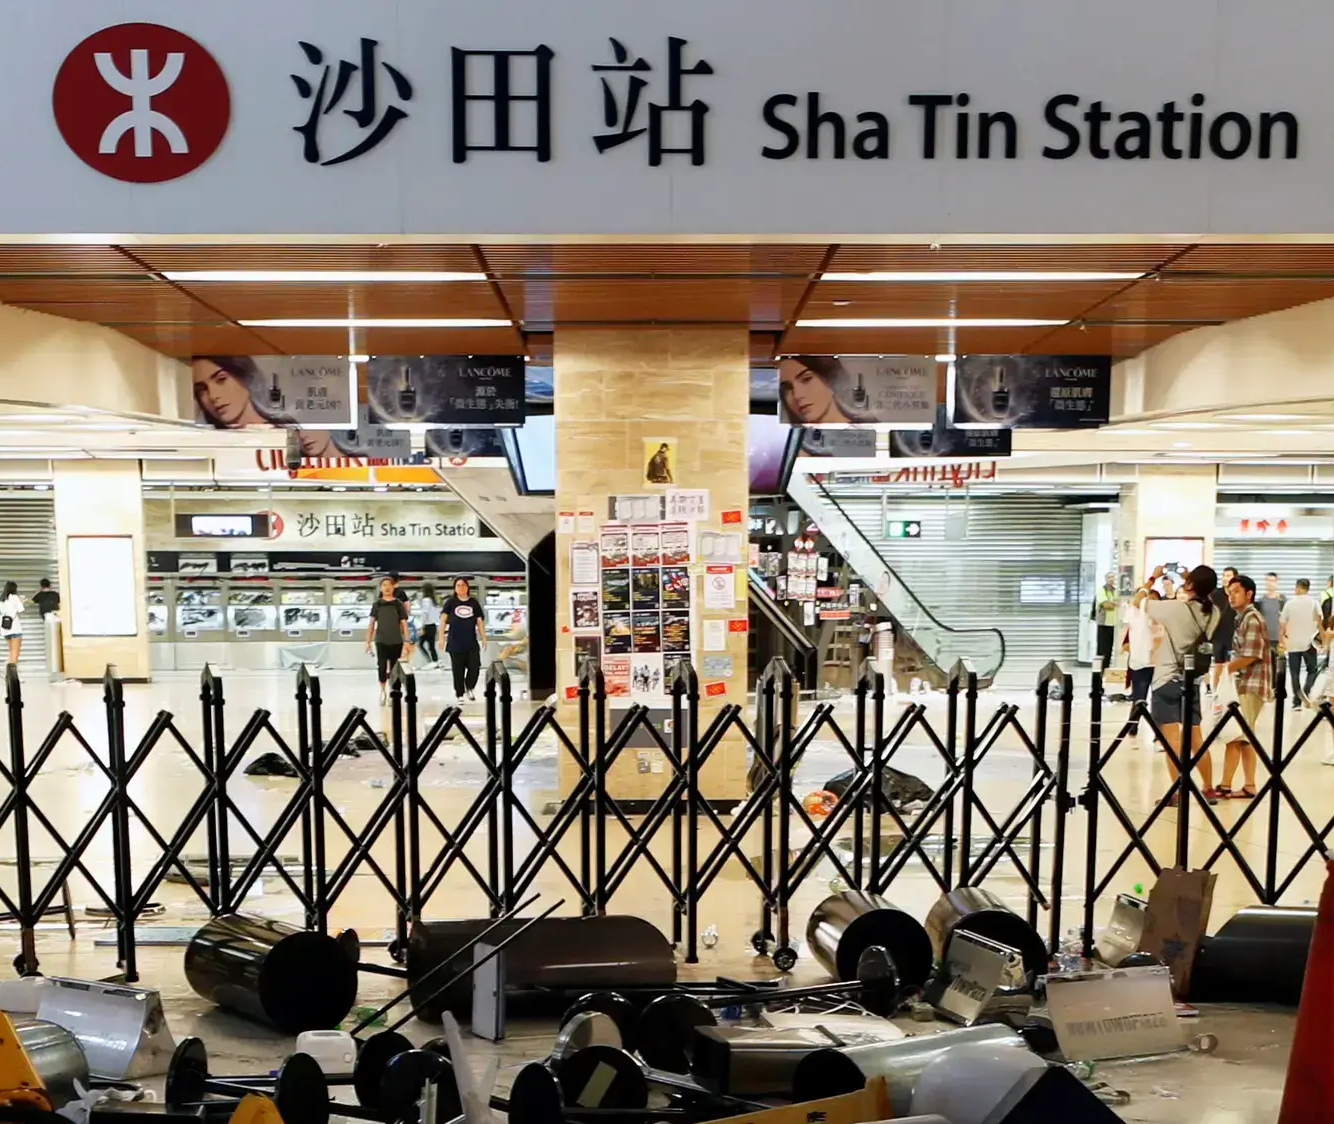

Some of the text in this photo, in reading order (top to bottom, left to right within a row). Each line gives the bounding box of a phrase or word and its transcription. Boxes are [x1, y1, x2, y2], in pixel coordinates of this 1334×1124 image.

[291, 37, 714, 167] 沙田站
[761, 91, 1299, 160] Sha Tin Station
[297, 512, 376, 539] 沙田站
[381, 522, 476, 537] Sha Tin Statio
